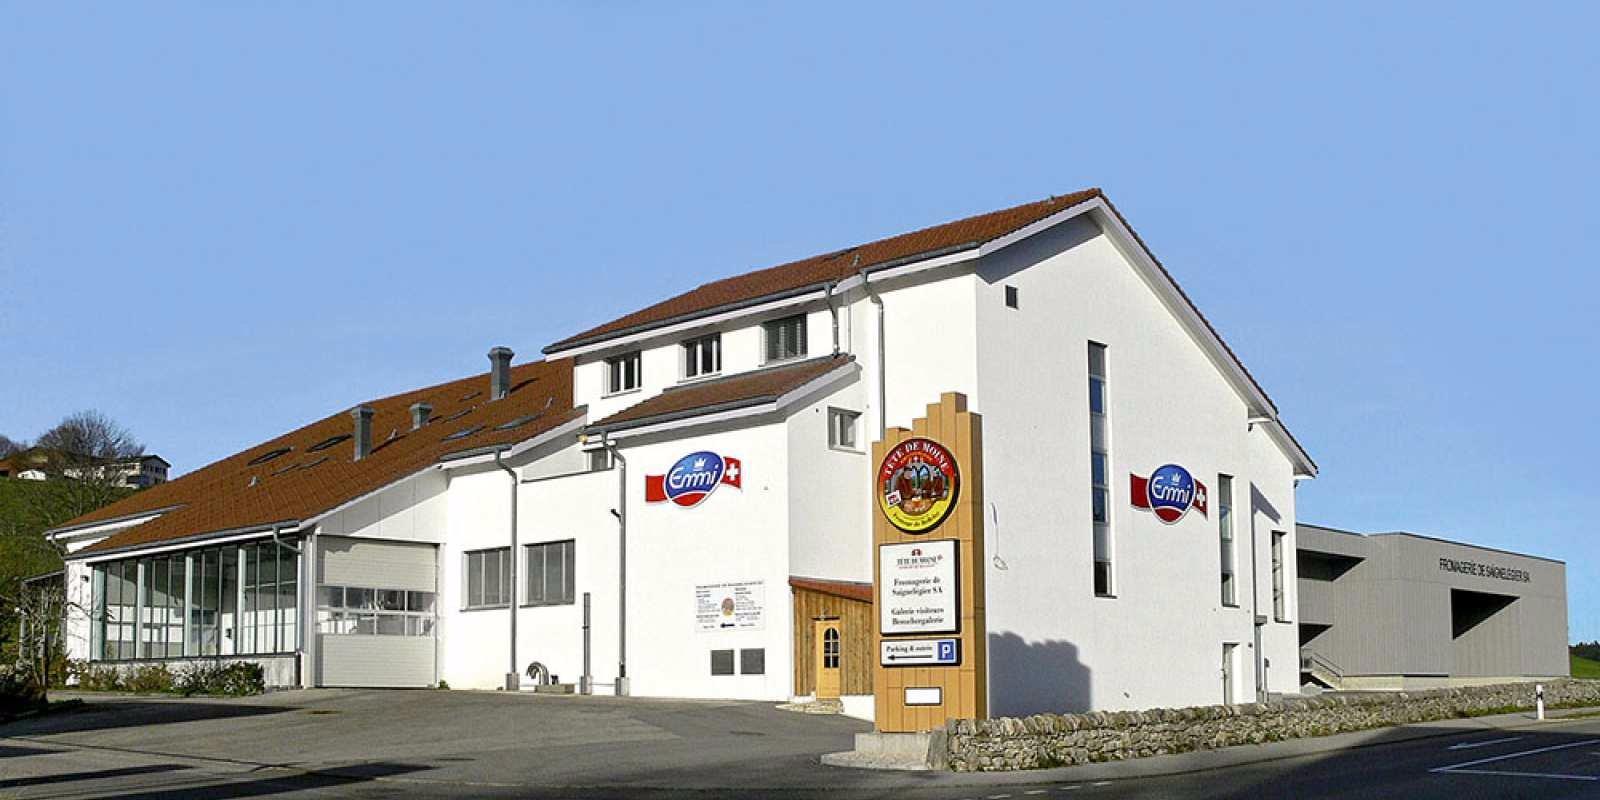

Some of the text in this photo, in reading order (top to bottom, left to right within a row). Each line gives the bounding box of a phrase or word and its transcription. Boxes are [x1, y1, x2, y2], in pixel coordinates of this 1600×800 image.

[905, 441, 919, 452] DE
[669, 464, 719, 489] Emmi
[1151, 476, 1191, 504] Emmi
[893, 576, 941, 587] Fromagerie de
[886, 645, 908, 654] Parking
[942, 643, 951, 659] P
